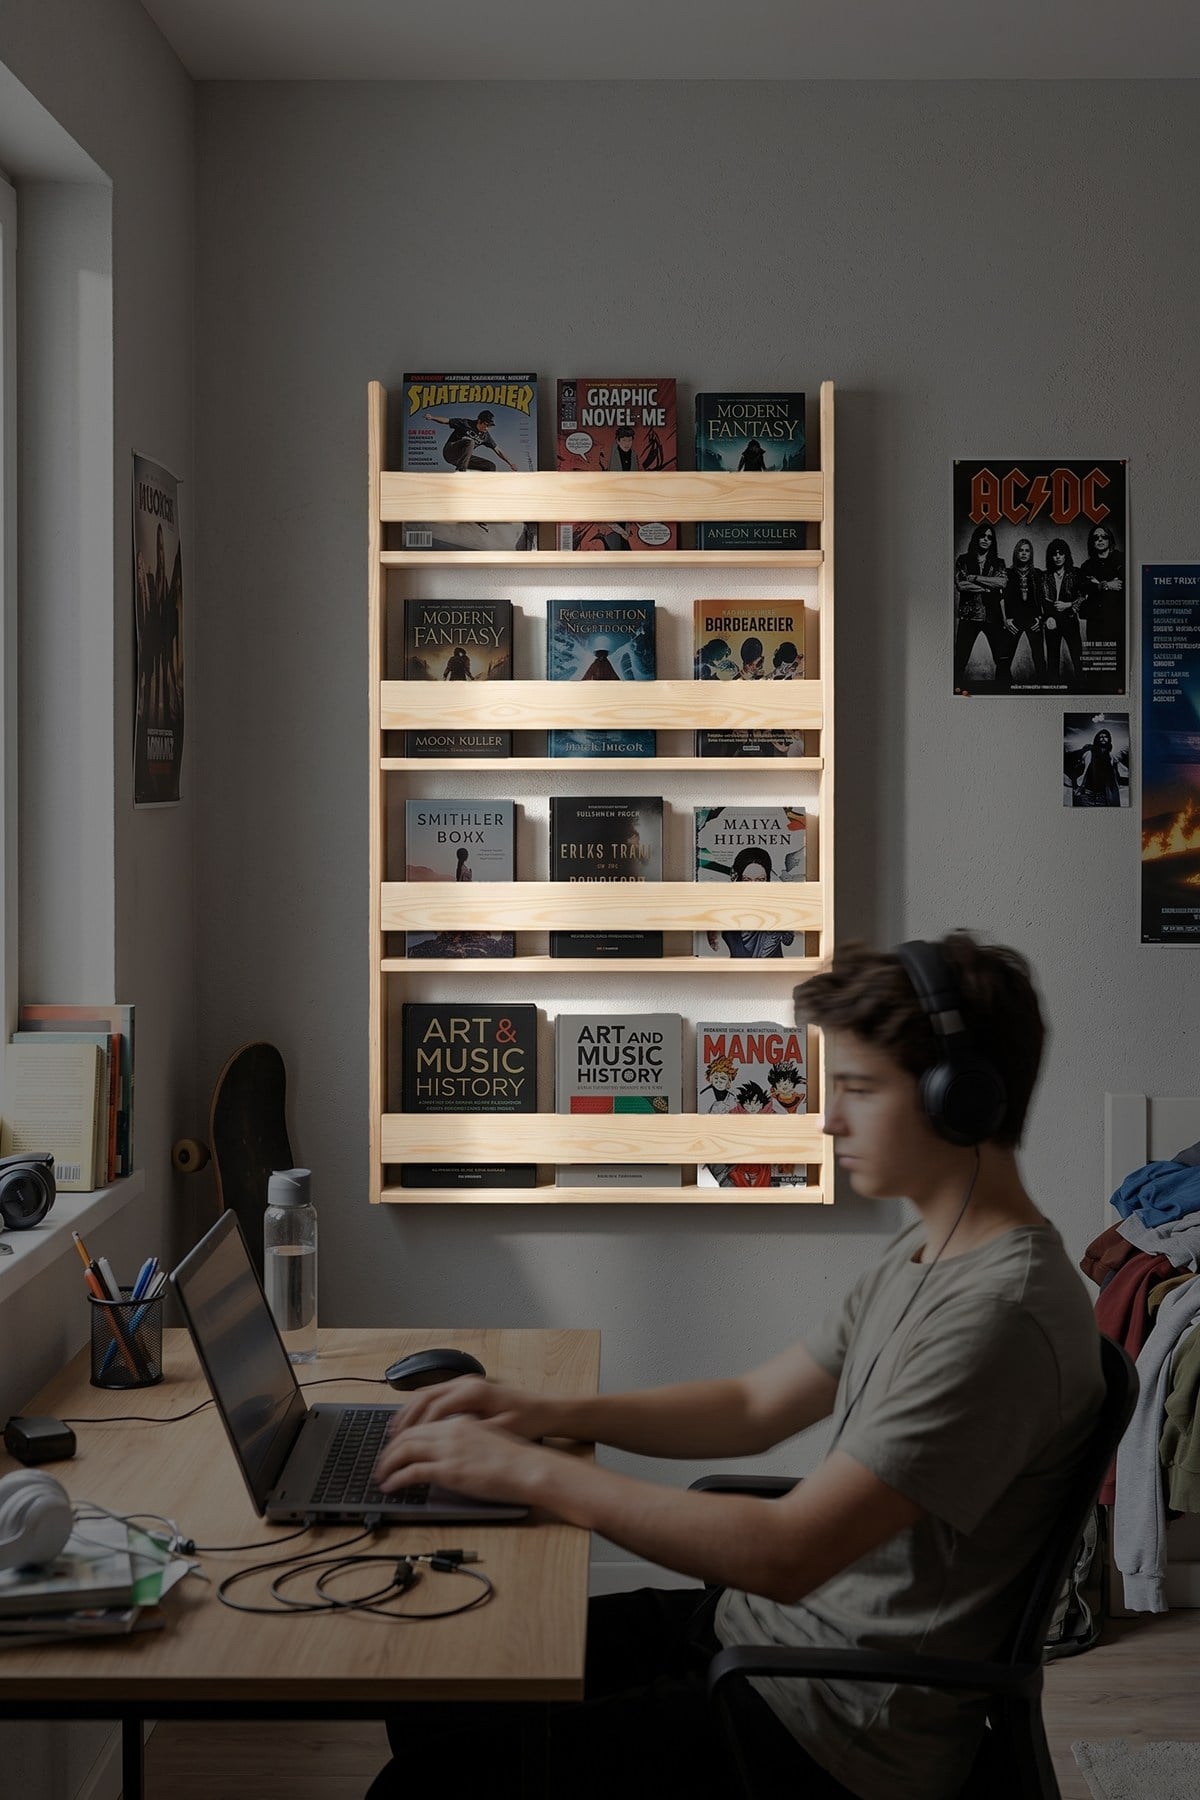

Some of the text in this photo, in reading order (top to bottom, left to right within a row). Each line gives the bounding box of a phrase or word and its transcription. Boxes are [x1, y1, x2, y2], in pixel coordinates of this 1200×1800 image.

[587, 388, 658, 407] GRAPHIC
[717, 404, 789, 418] MODERN
[708, 420, 799, 440] FANTASY
[708, 528, 797, 538] ANEON KULLER
[1153, 577, 1172, 585] THE
[423, 611, 494, 625] MODERN
[414, 626, 505, 648] FANTASY
[415, 736, 503, 746] MOON KULLER
[417, 813, 504, 826] SMITHLER
[724, 819, 781, 830] MAIYA
[561, 843, 604, 859] ERLKS
[422, 1018, 517, 1044] ART &
[577, 1025, 663, 1044] ART AND
[577, 1045, 663, 1066] MUSIC
[703, 1034, 803, 1064] MANGA
[417, 1047, 525, 1074] MUSIC
[577, 1067, 663, 1083] HISTORY
[416, 1078, 525, 1097] HISTORY
